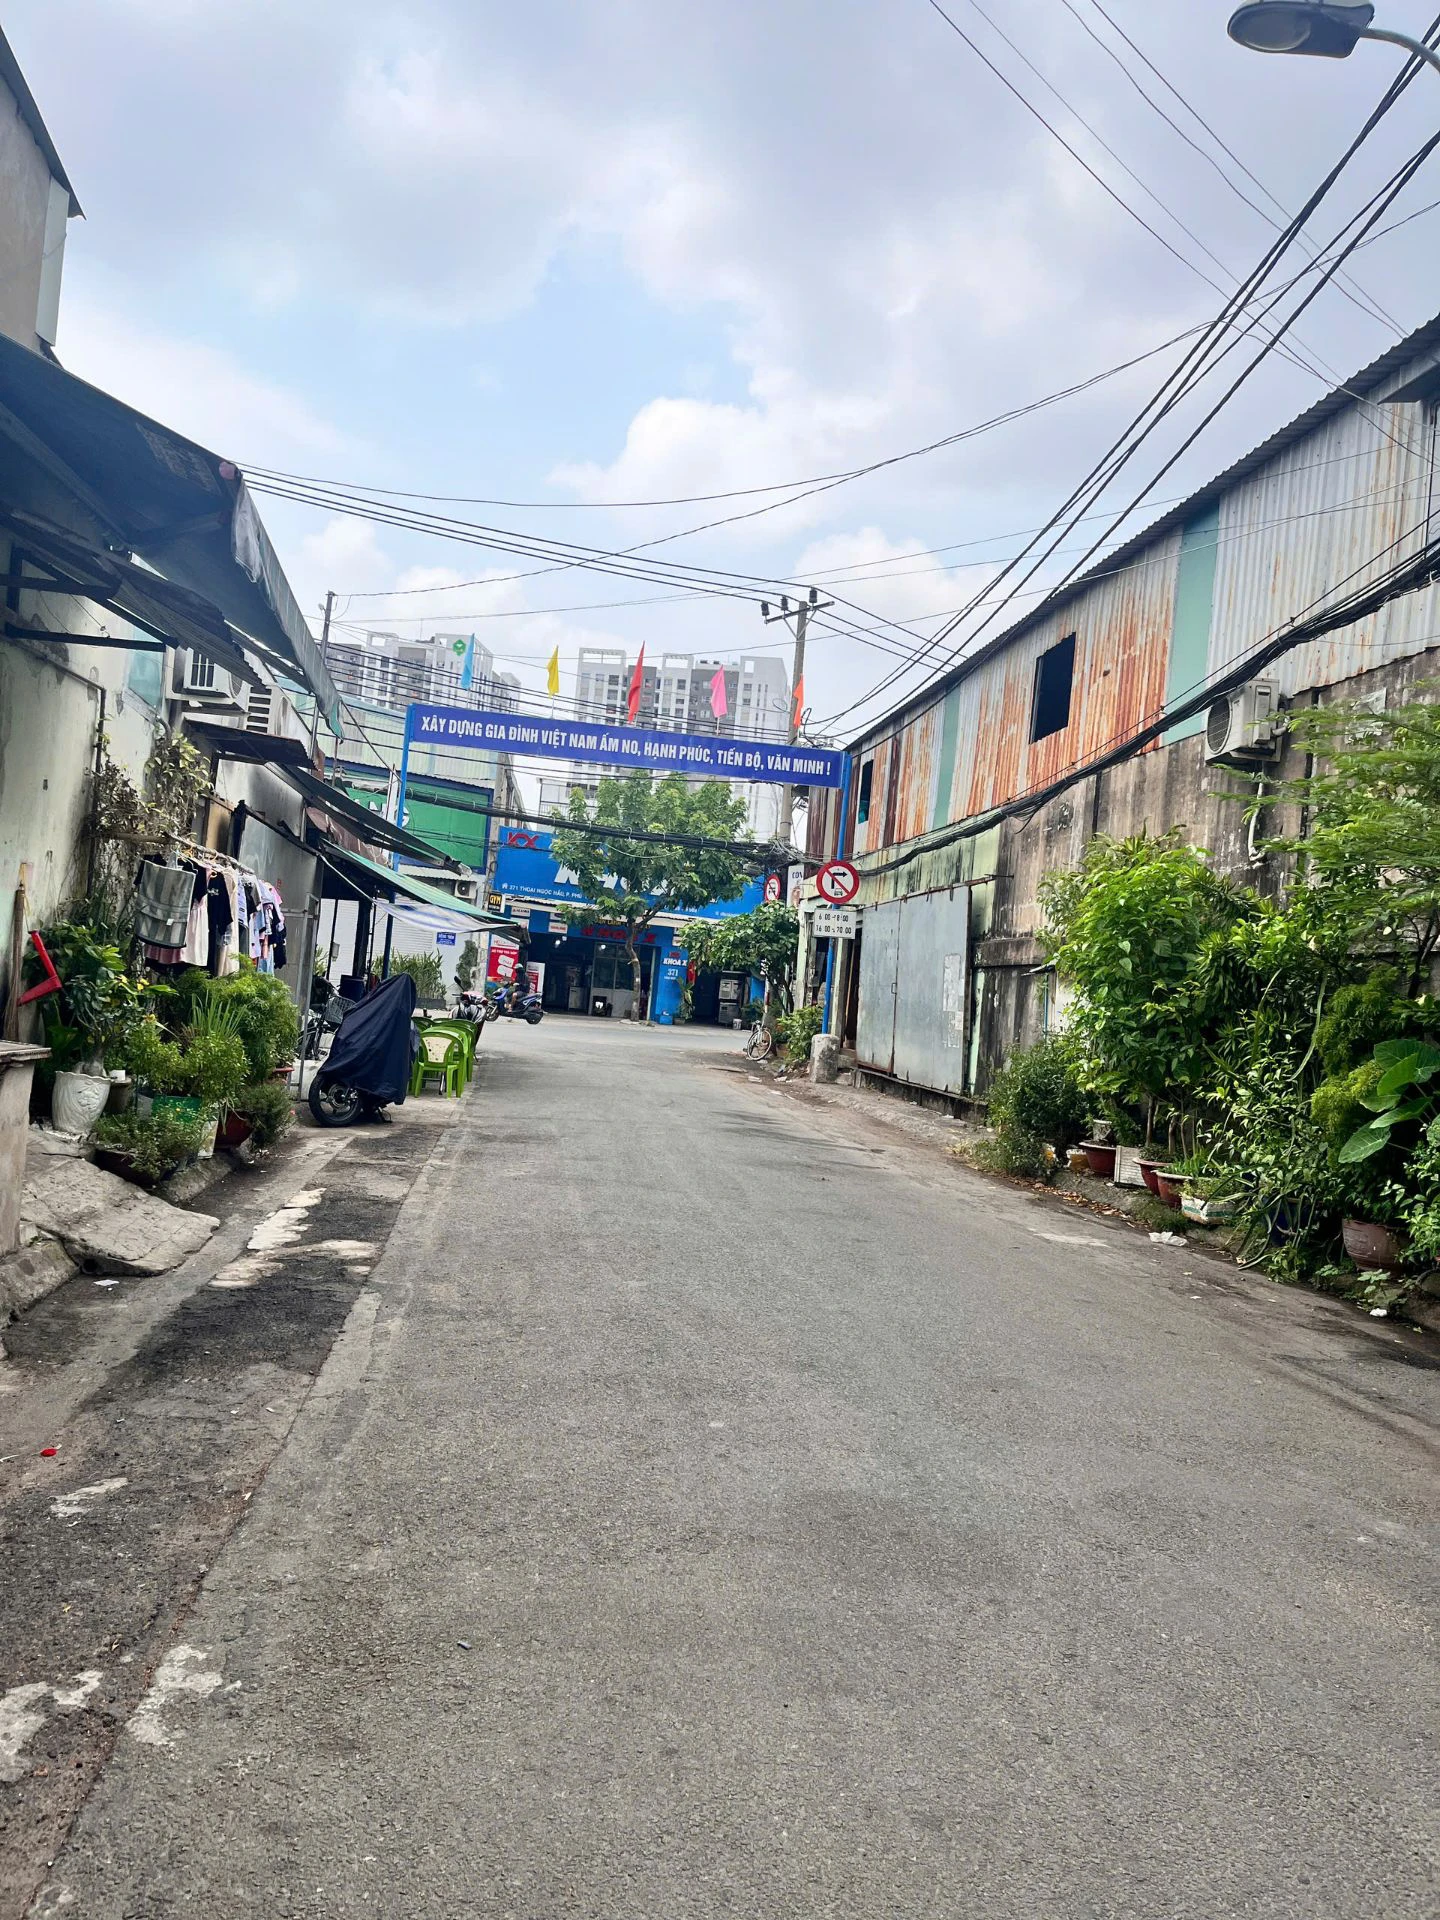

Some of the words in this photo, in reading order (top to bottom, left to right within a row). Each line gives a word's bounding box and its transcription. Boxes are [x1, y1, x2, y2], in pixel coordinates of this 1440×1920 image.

[421, 715, 446, 733] XÂY
[448, 719, 483, 738] DỰNG
[485, 724, 506, 740] GIA
[508, 723, 539, 744] ĐÌNH
[541, 728, 567, 749] VIỆT
[569, 734, 597, 750] NAM
[600, 732, 619, 752] ẤM
[621, 739, 641, 756] NO,
[643, 742, 677, 760] HẠNH
[679, 744, 714, 764] PHÚC,
[717, 747, 742, 767] TIẾN
[745, 752, 764, 771] BỘ,
[767, 754, 790, 771] VĂN
[792, 758, 824, 775] MINH
[663, 957, 681, 966] KHOA
[682, 959, 688, 967] X
[667, 968, 679, 977] 371
